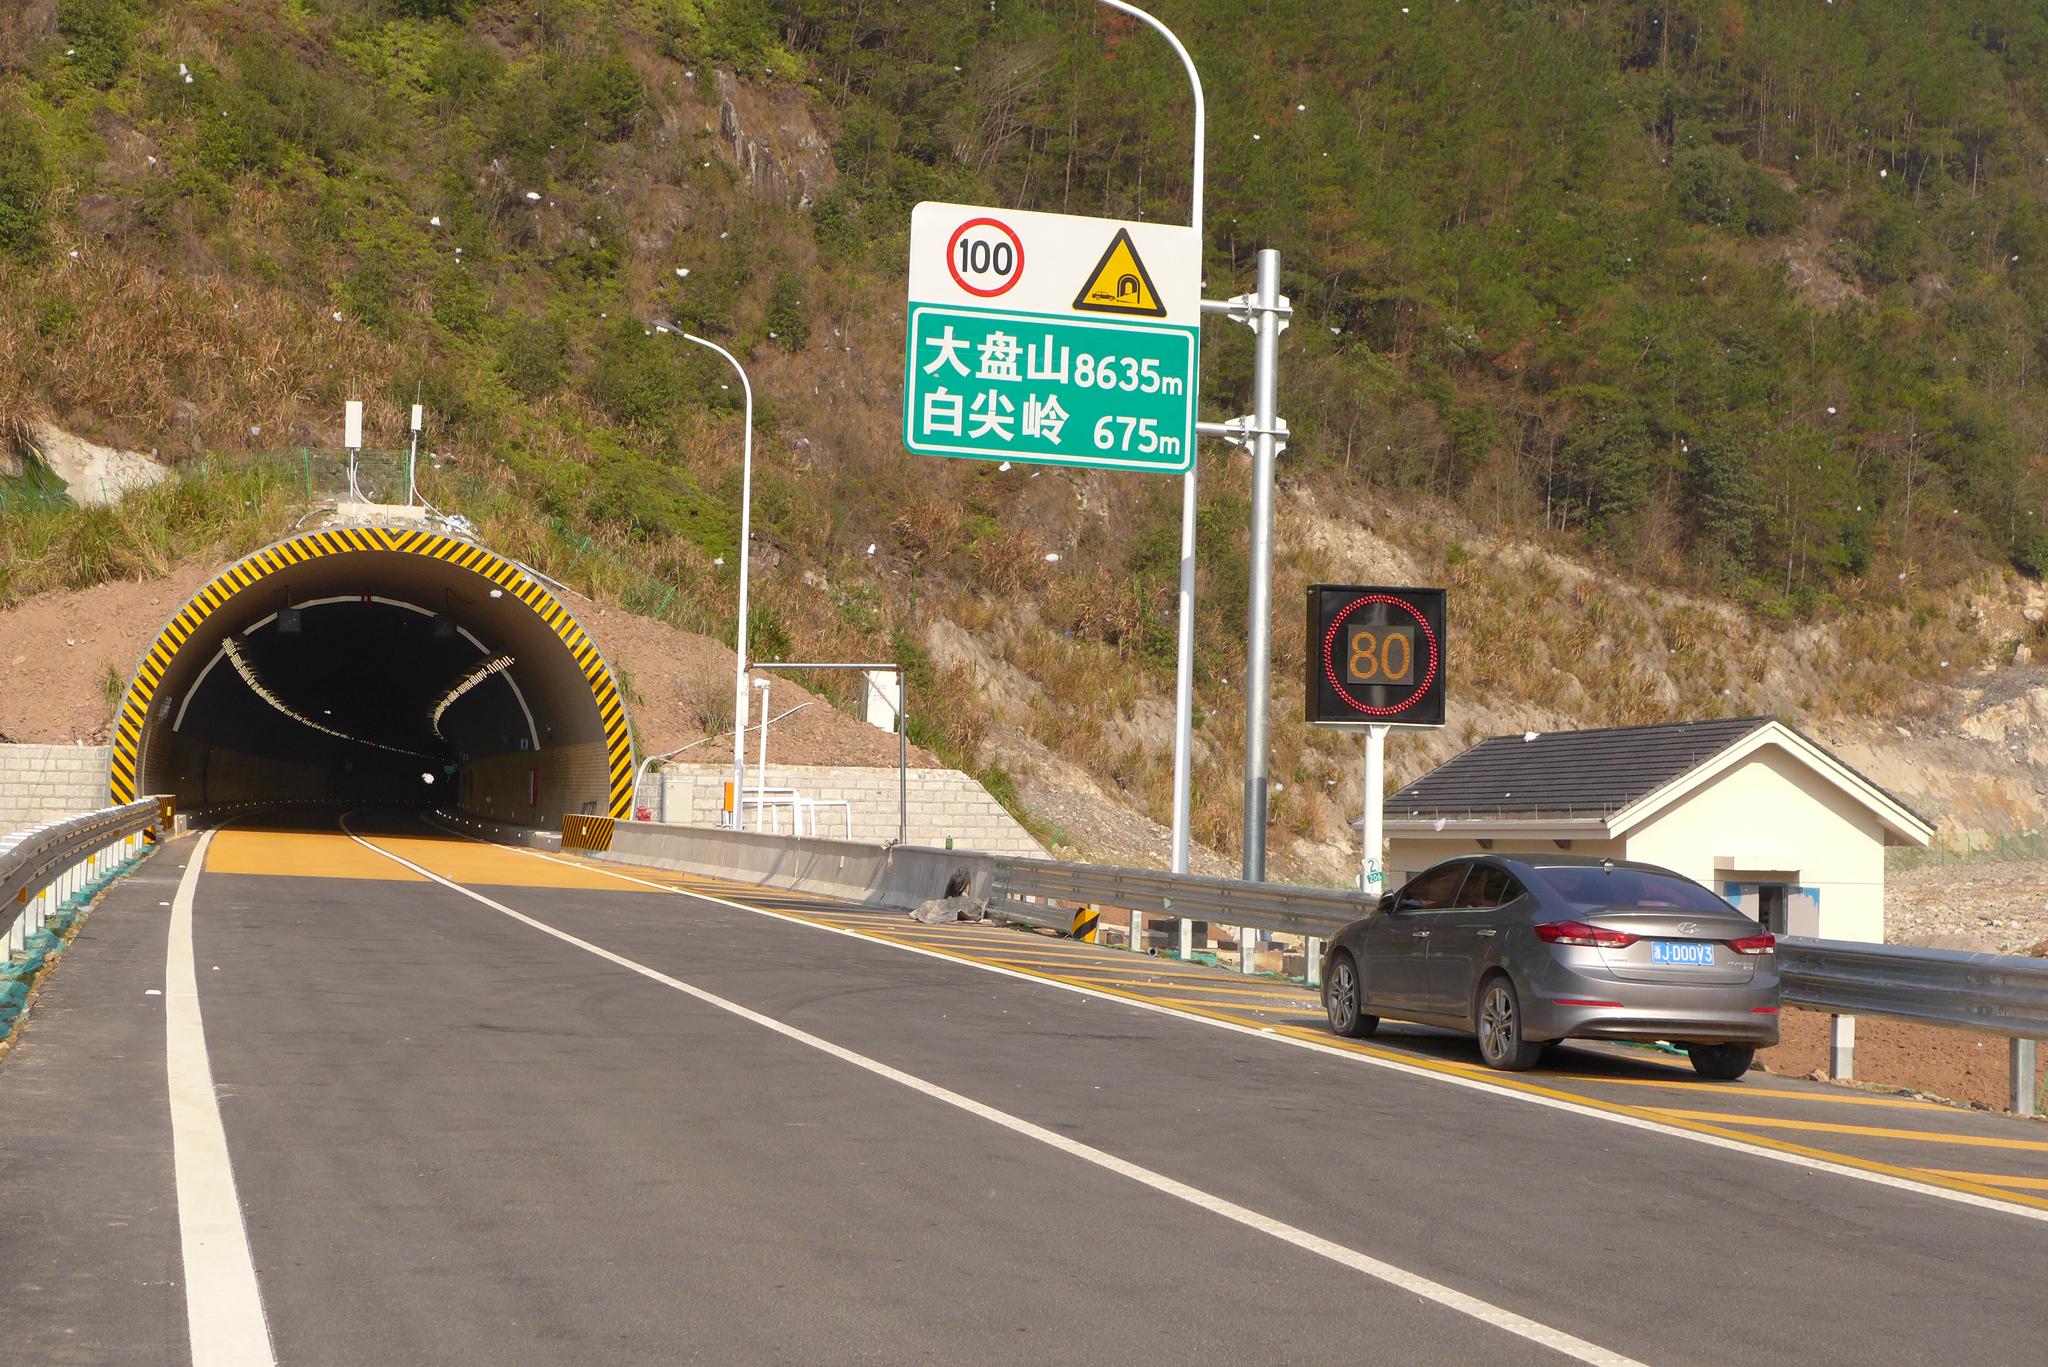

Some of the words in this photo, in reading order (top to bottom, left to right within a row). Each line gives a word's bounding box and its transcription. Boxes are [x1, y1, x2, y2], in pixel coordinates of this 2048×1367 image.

[960, 239, 1013, 276] 100
[922, 325, 1070, 384] 大盘山
[1074, 353, 1183, 396] 8635m
[922, 386, 1070, 445] 白尖岭
[1093, 415, 1180, 455] 675m
[1350, 631, 1411, 680] 80
